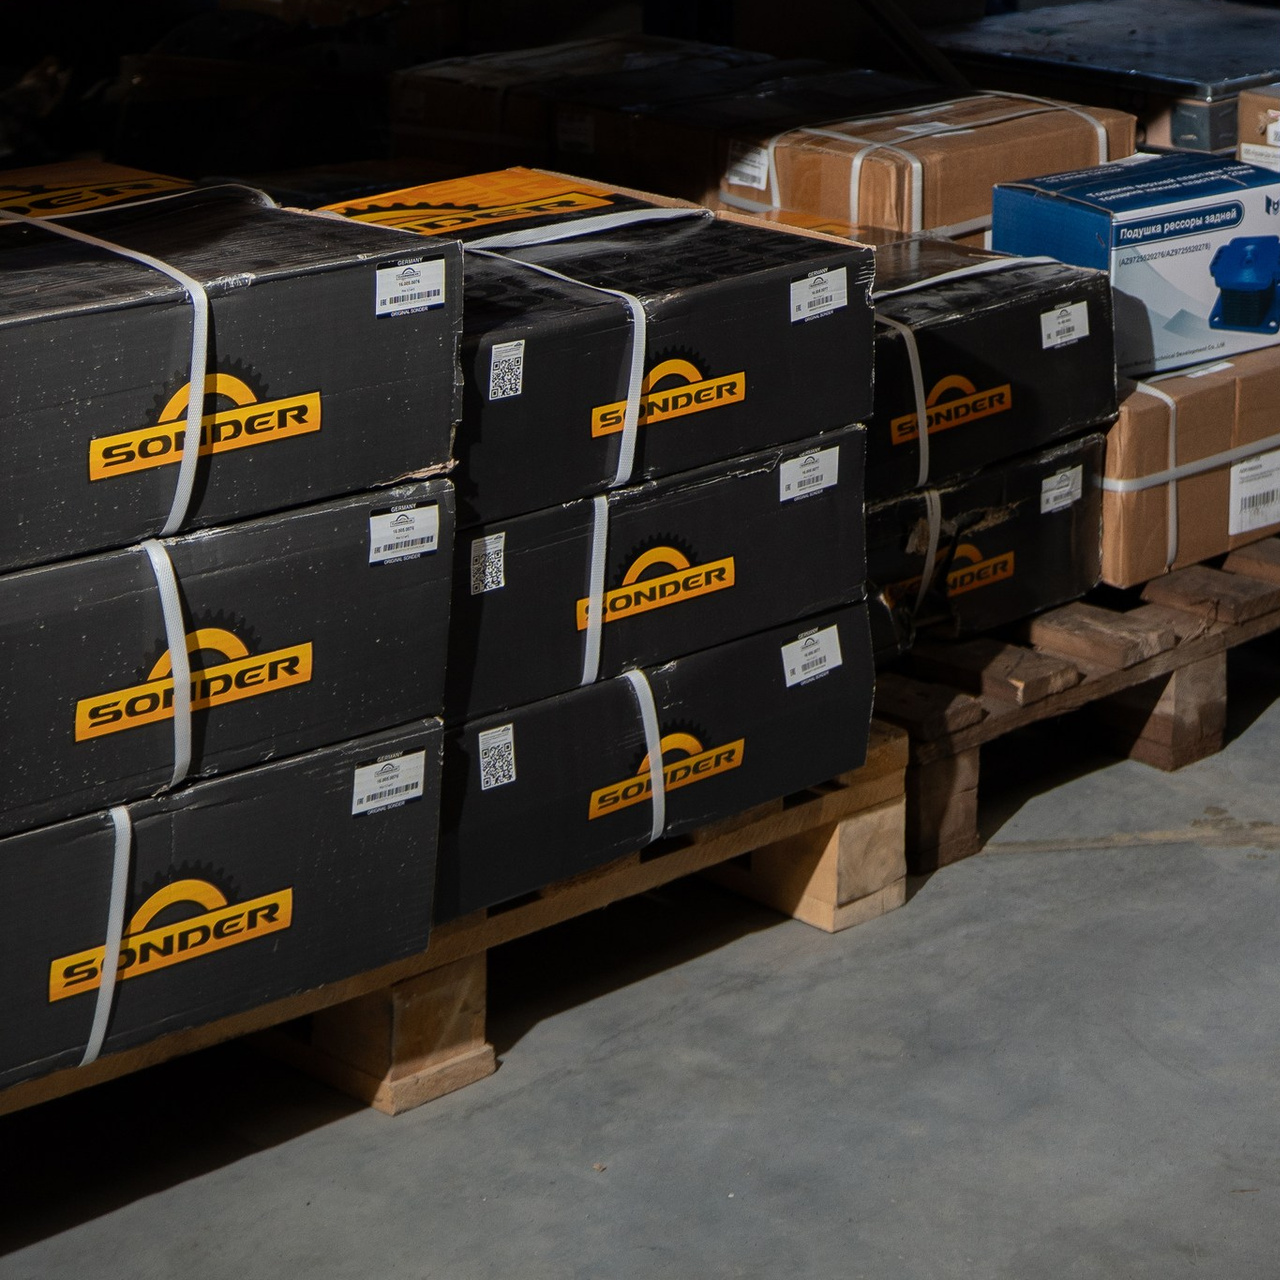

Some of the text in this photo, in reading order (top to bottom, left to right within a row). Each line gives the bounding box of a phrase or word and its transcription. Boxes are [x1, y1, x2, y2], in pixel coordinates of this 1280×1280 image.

[400, 200, 586, 233] DER
[1120, 209, 1237, 240] Подушка рессоры задней
[397, 257, 423, 266] GERMANY
[391, 503, 416, 513] GERMANY
[377, 751, 403, 762] GERMANY
